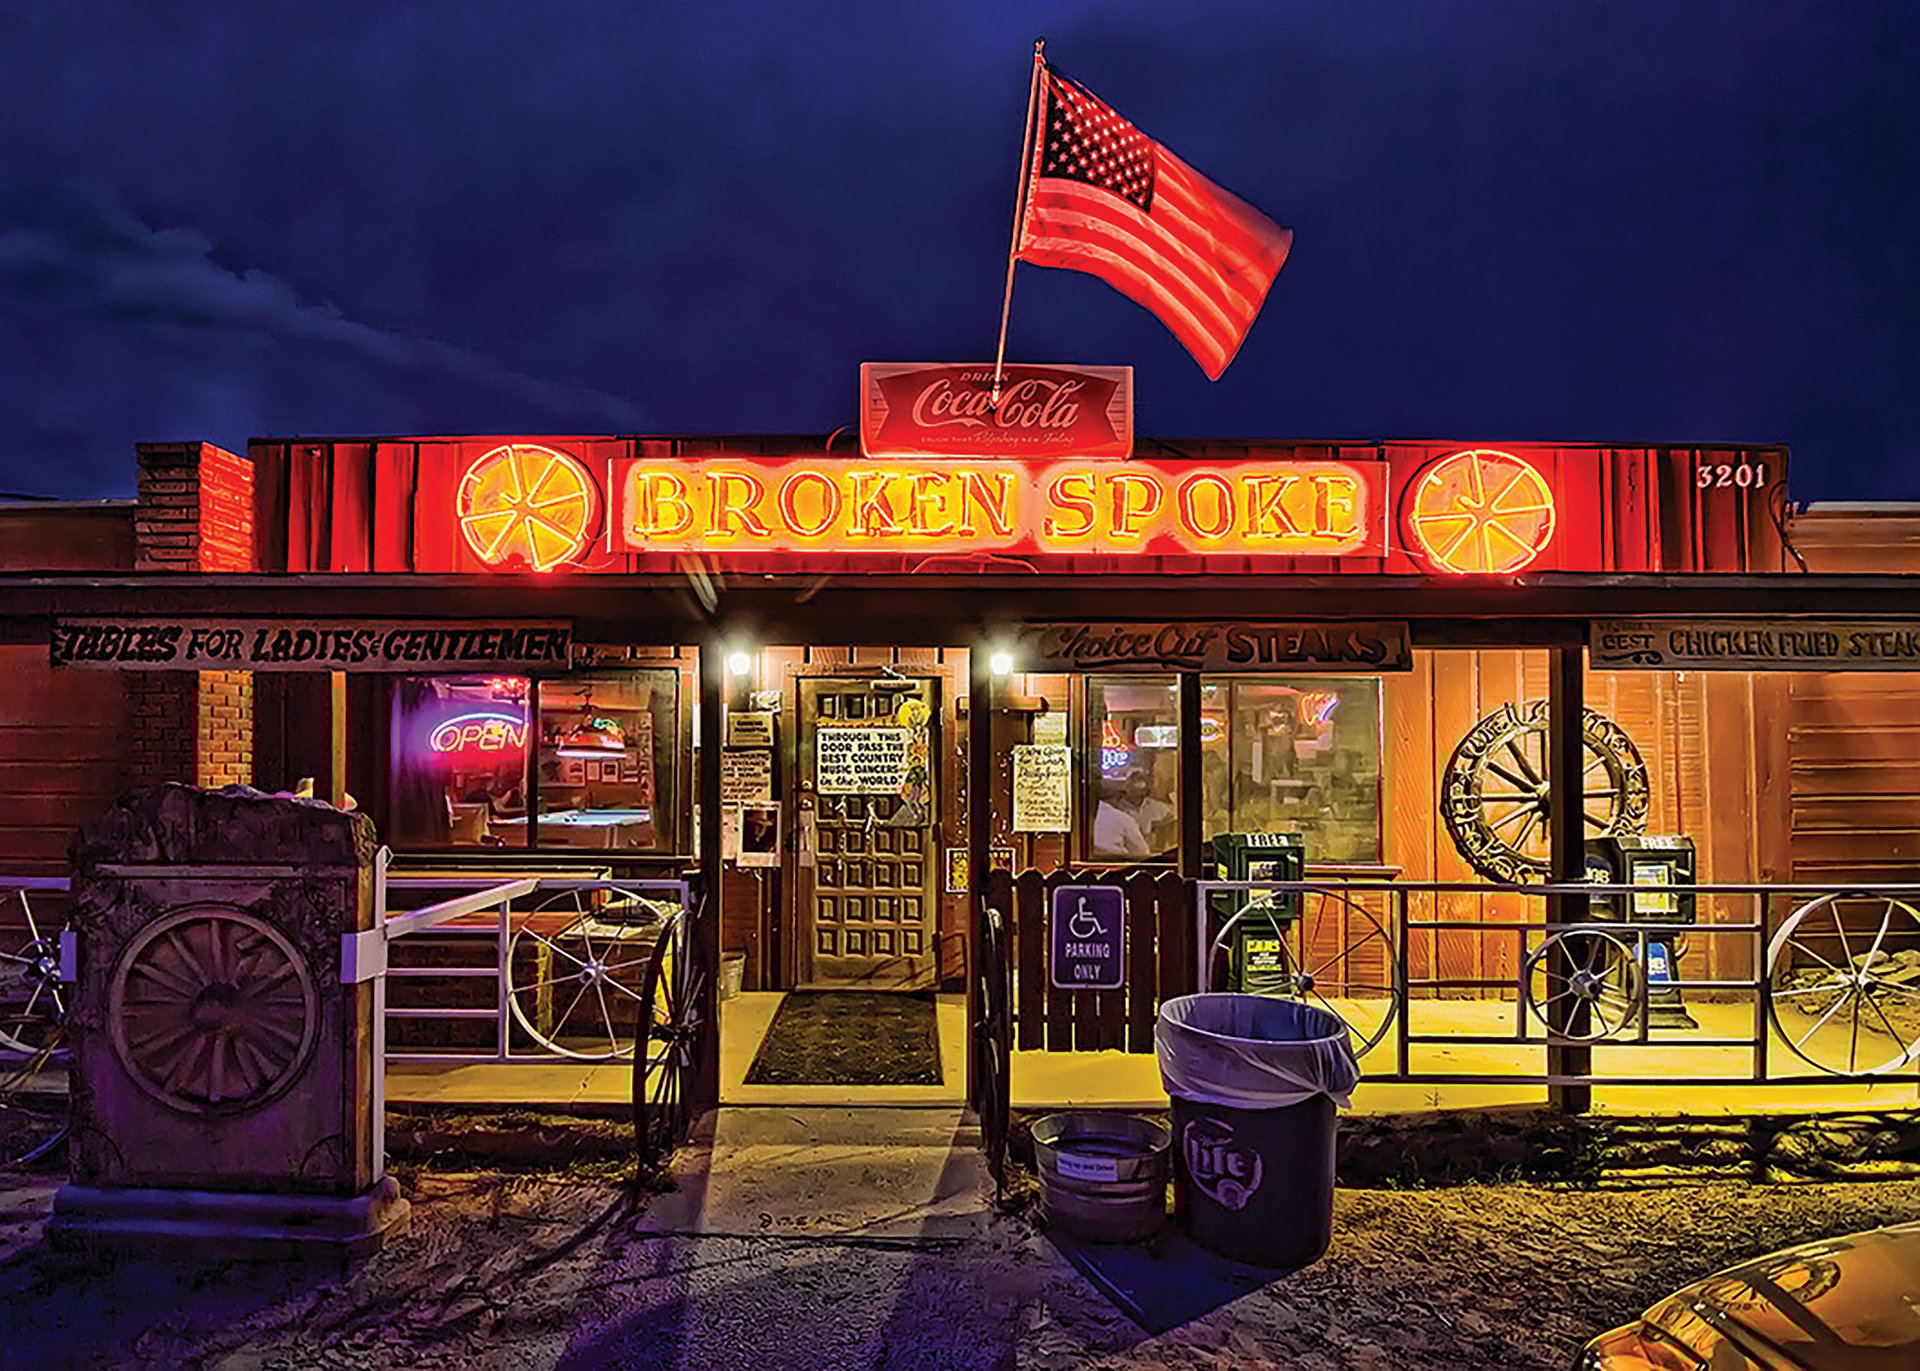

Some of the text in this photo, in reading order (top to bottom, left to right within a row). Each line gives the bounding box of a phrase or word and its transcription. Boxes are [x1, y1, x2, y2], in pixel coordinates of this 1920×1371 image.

[912, 378, 1085, 428] CocaCola
[1697, 463, 1765, 488] 3201
[633, 471, 1361, 539] BROKEN SPOKE
[54, 625, 183, 661] TABLES
[185, 628, 245, 659] FOR
[251, 629, 373, 662] LADIES
[382, 628, 570, 662] GENTLEMEN
[1226, 628, 1388, 664] STEAKS
[1601, 633, 1656, 651] BEST
[1668, 630, 1778, 657] CHICKEN
[1779, 630, 1839, 657] FRIED
[436, 723, 529, 752] OPEN
[821, 732, 902, 742] THROUGH THIS
[821, 743, 904, 752] DOOR PASS THE
[821, 753, 904, 763] BEST COUNTRY
[820, 765, 852, 774] MUSIC
[819, 776, 832, 786] in
[1248, 833, 1288, 848] FREE
[1641, 836, 1675, 849] FREE
[1065, 942, 1110, 958] PARKING
[1074, 964, 1101, 979] ONLY
